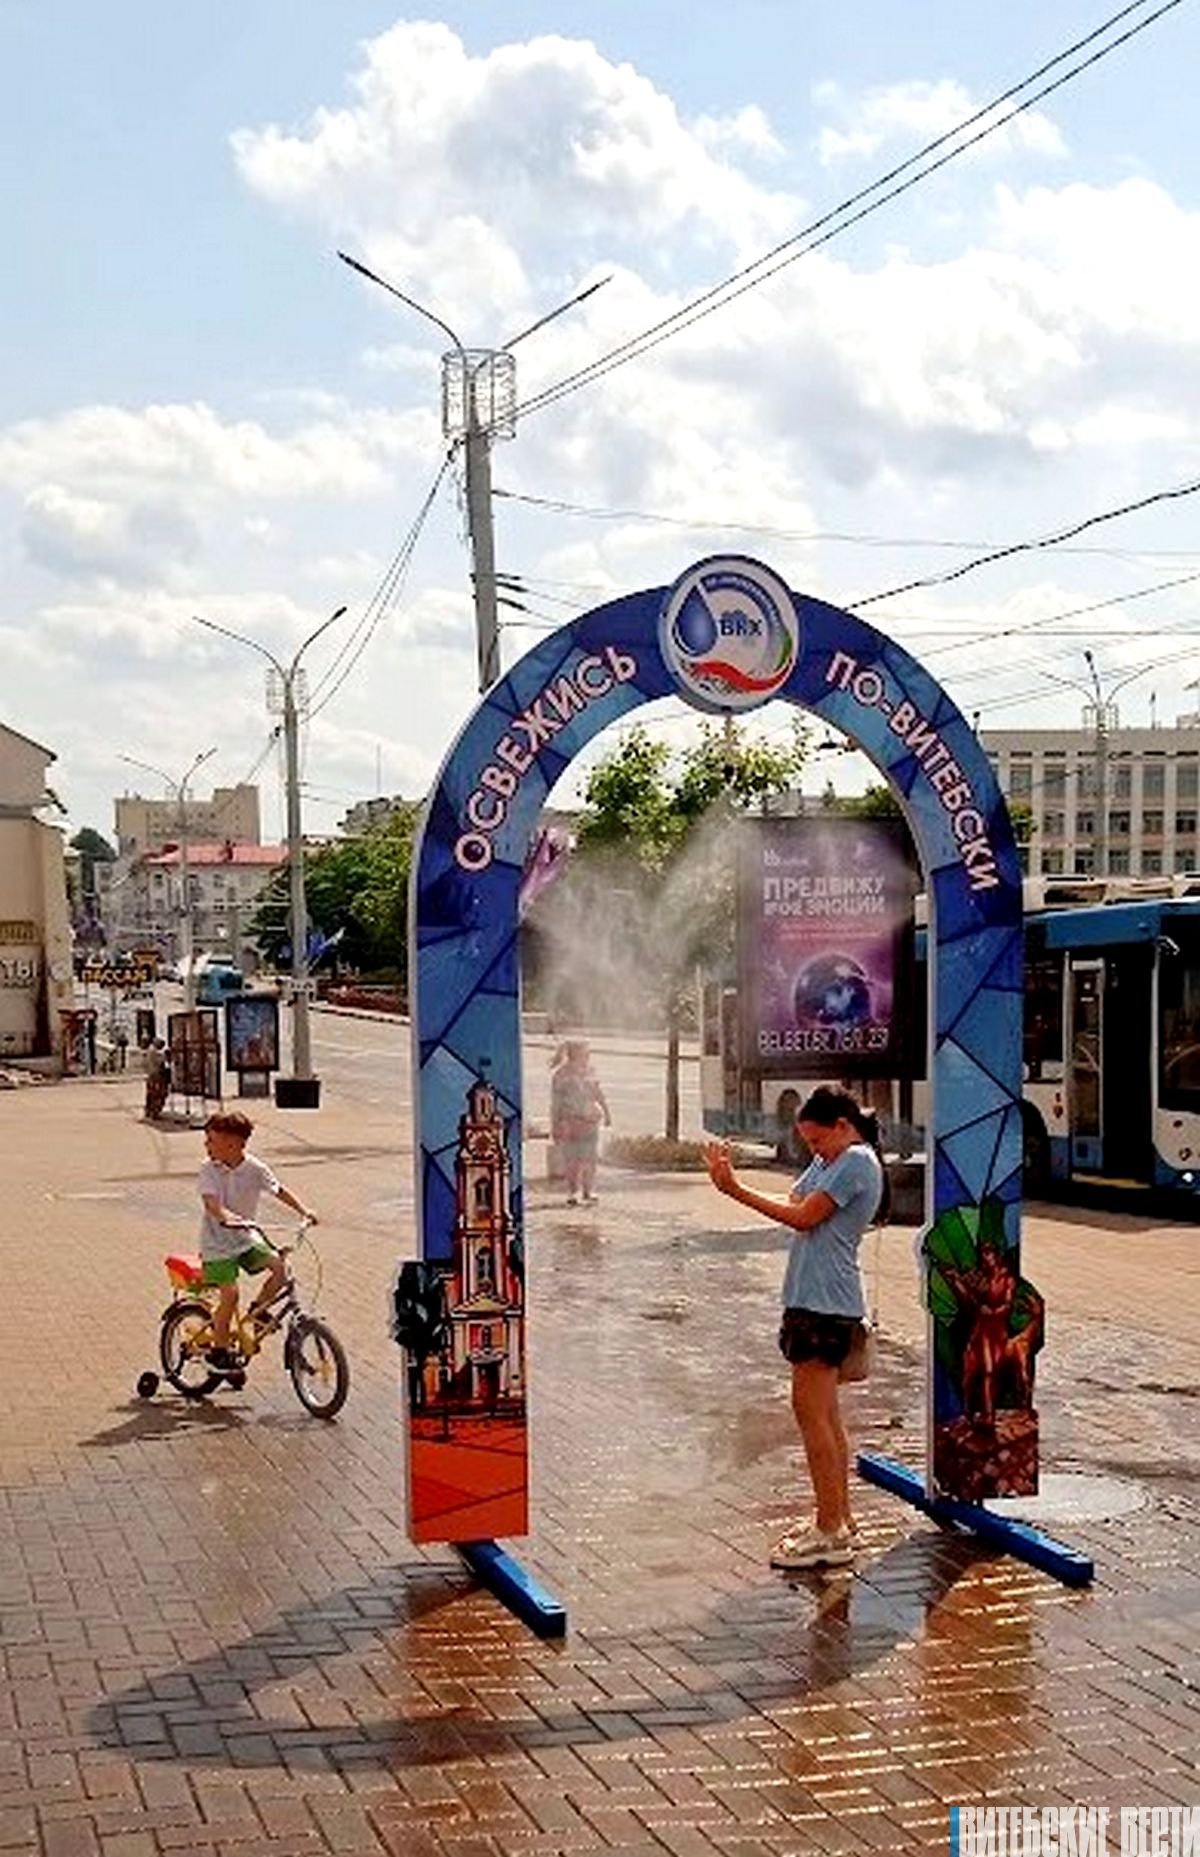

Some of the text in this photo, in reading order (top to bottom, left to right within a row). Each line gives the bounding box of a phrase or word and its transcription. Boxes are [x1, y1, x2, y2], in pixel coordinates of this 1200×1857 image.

[454, 647, 639, 873] ОСВЕЖИСЬ
[825, 650, 1000, 892] ПО-ВИТЕБСКИ
[763, 876, 886, 900] ПРЕДВИЖУ
